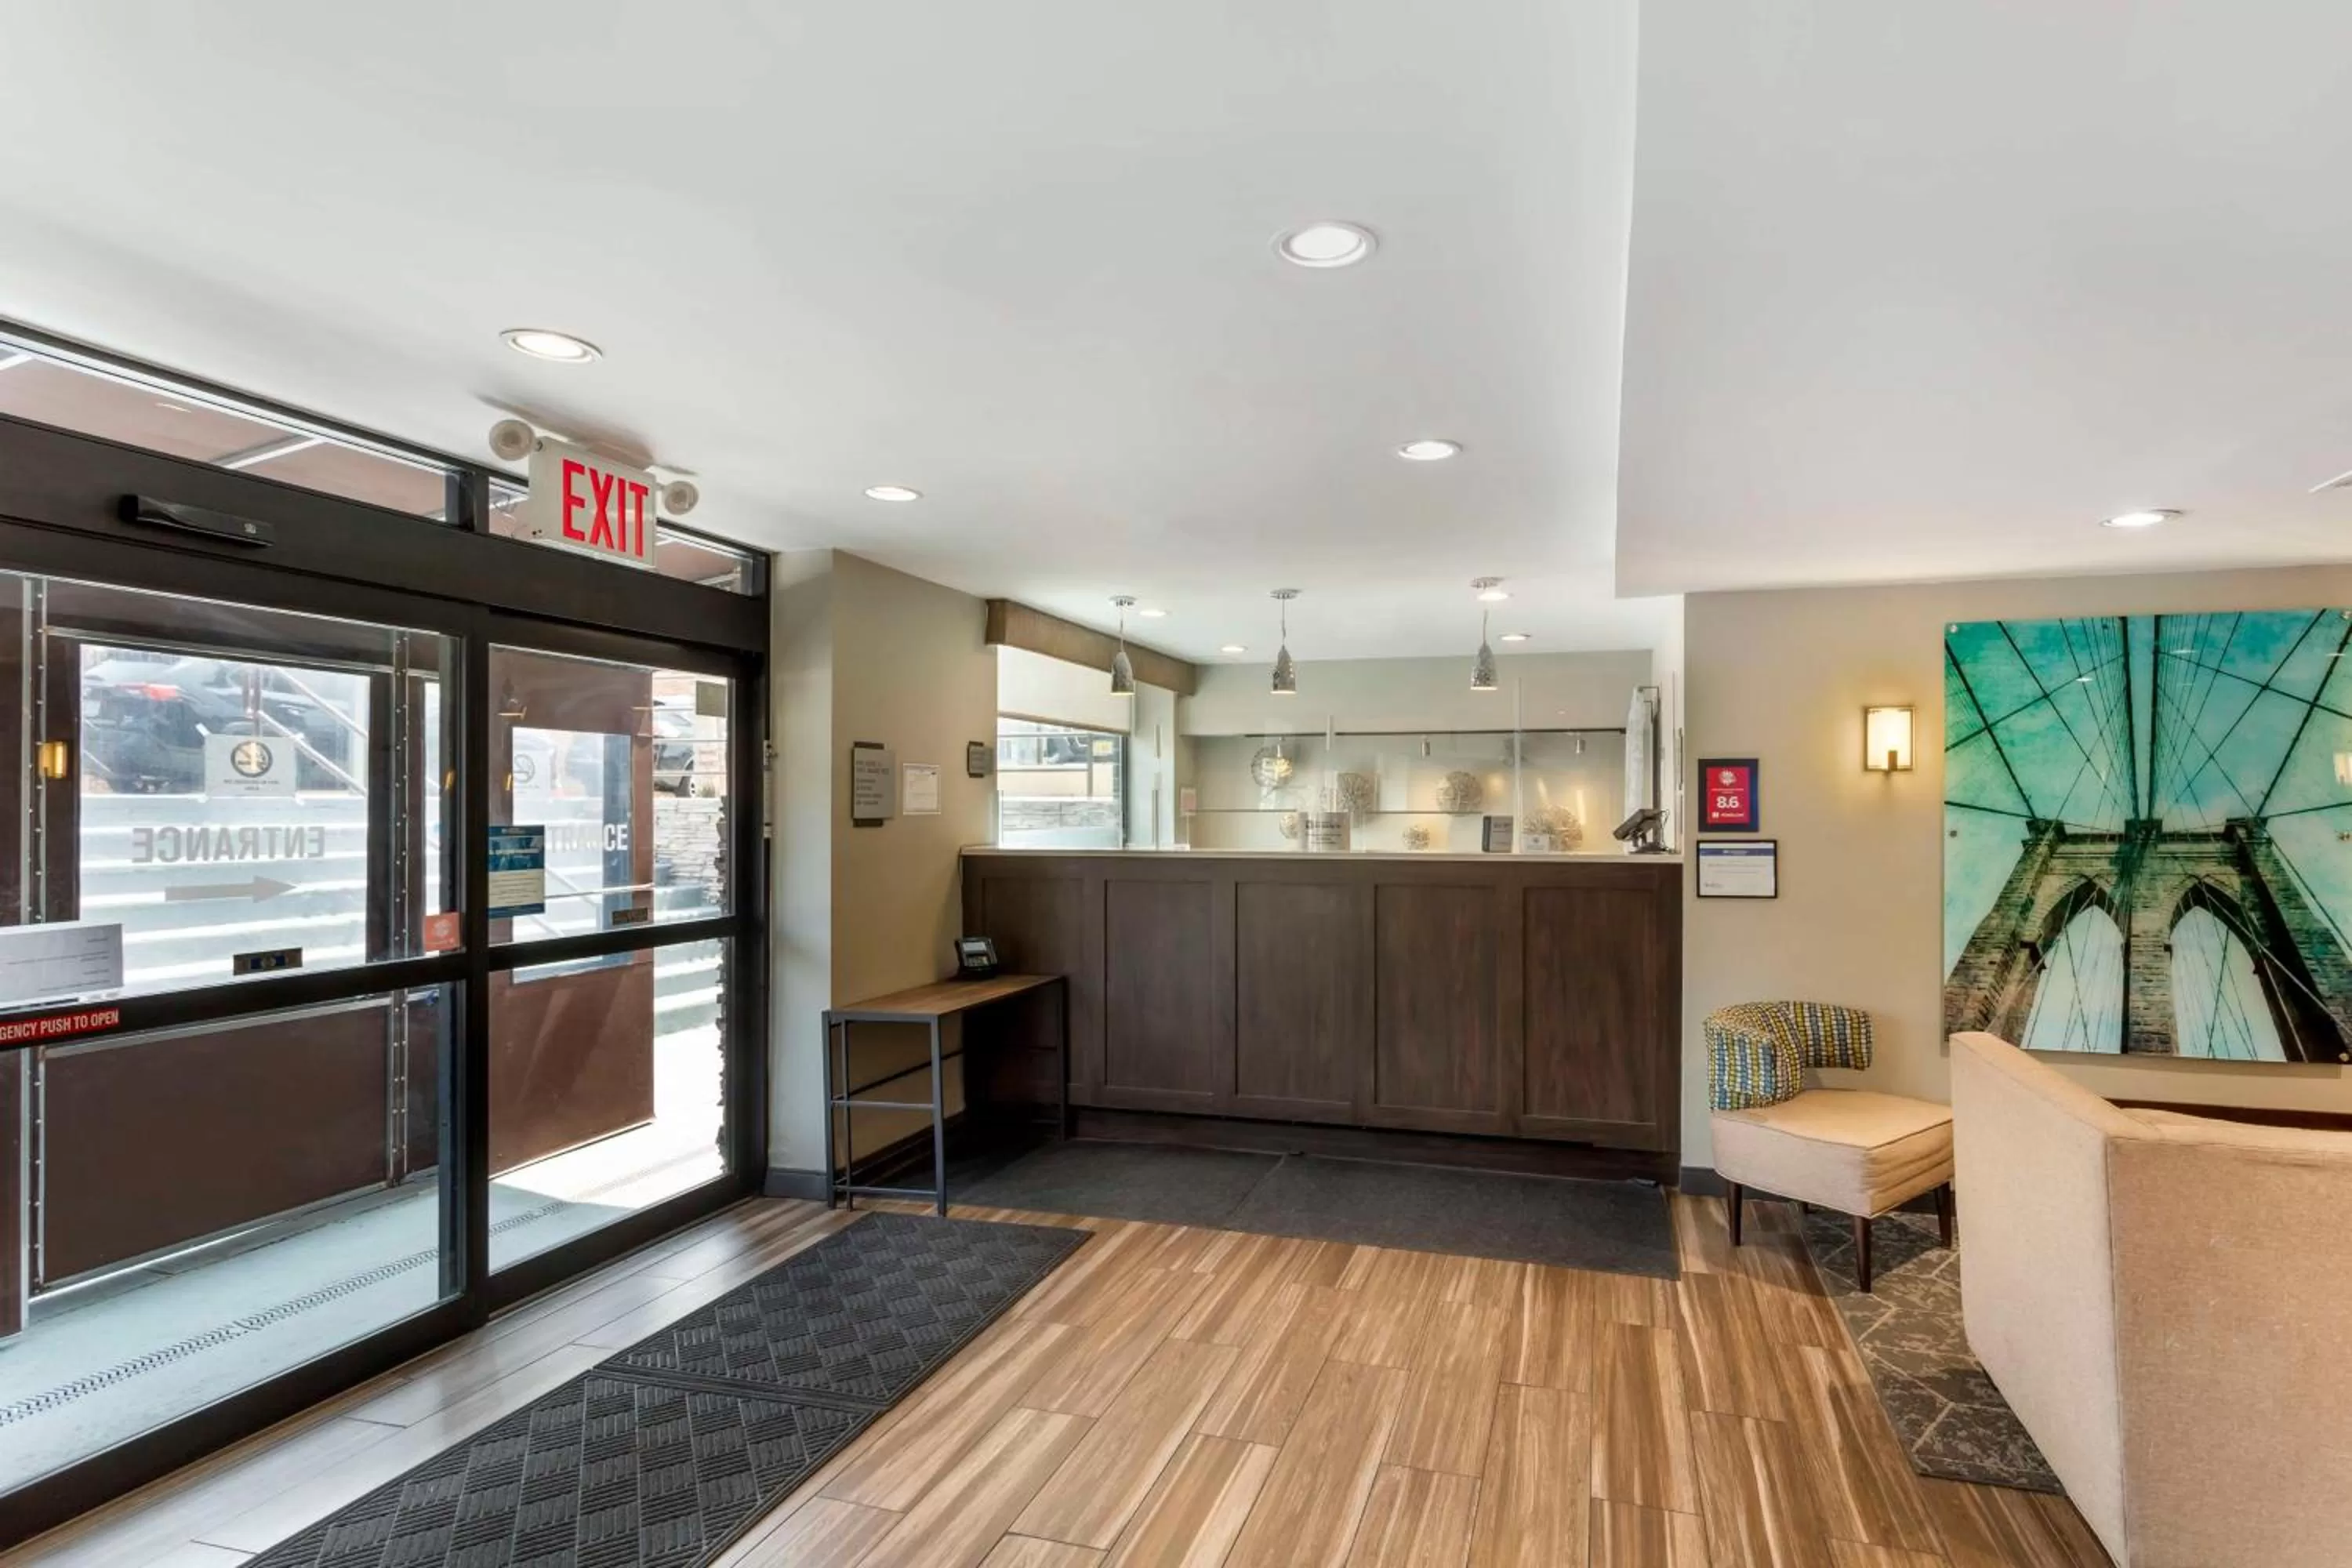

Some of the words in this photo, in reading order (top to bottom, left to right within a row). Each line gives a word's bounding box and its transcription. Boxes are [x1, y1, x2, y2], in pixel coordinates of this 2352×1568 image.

[562, 458, 649, 558] EXIT
[1716, 796, 1740, 808] 8.6
[40, 1016, 71, 1034] PUSH
[73, 1014, 89, 1029] TO
[90, 1009, 120, 1027] OPEN
